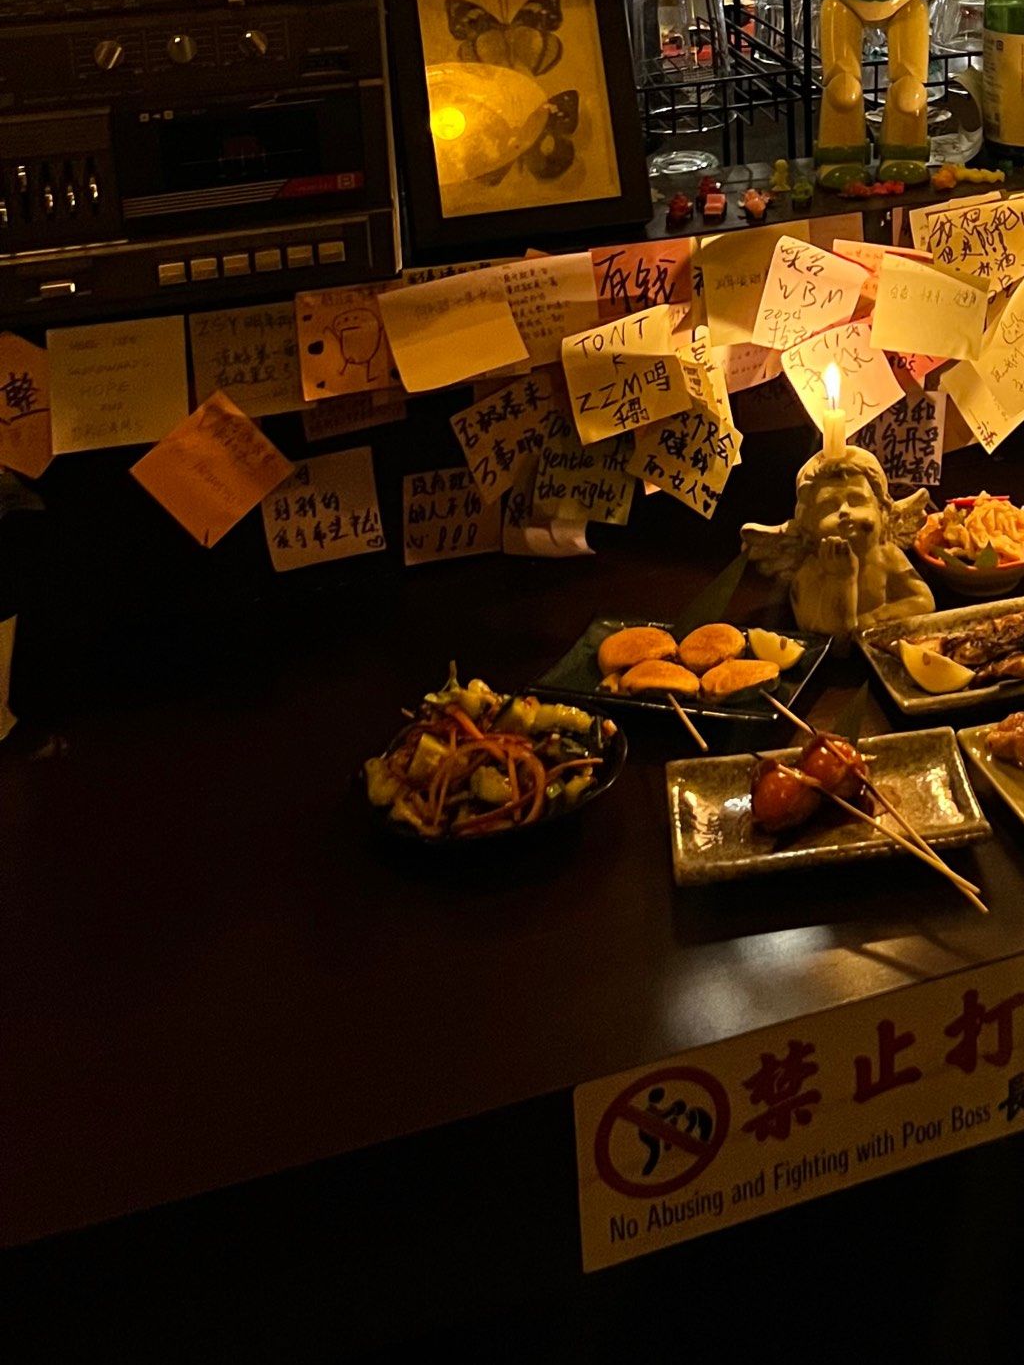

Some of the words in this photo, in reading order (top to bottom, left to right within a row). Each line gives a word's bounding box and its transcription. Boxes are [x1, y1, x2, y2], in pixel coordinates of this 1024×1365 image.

[540, 444, 595, 475] gentle
[537, 482, 568, 500] the
[609, 1213, 639, 1243] No
[646, 1188, 724, 1233] Abusing
[731, 1170, 766, 1204] and
[773, 1146, 849, 1192] Fighting
[856, 1132, 896, 1164] with
[902, 1115, 944, 1148] Poor
[951, 1103, 992, 1131] Boss
